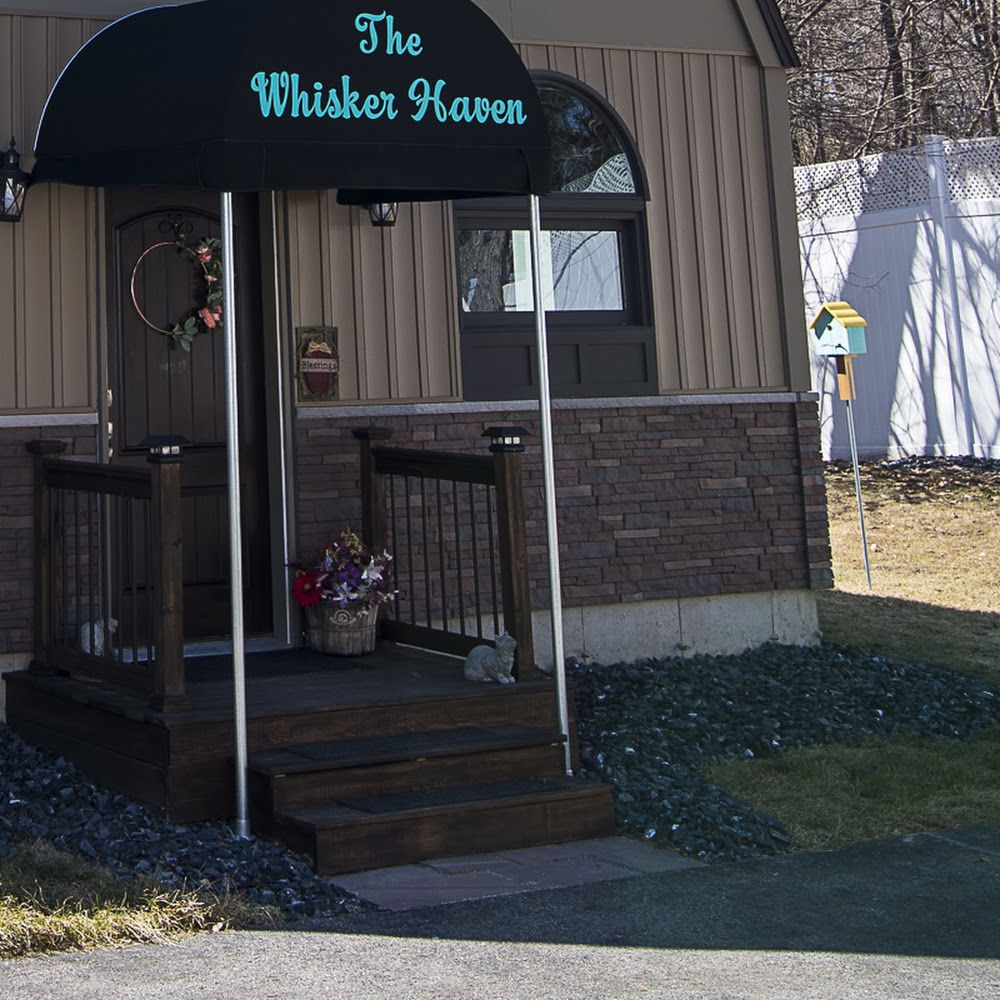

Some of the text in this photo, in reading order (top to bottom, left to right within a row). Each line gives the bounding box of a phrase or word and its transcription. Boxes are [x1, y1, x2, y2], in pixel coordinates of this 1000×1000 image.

[354, 10, 423, 57] The
[250, 71, 527, 125] Whisker Haven
[301, 360, 338, 372] Blessings
